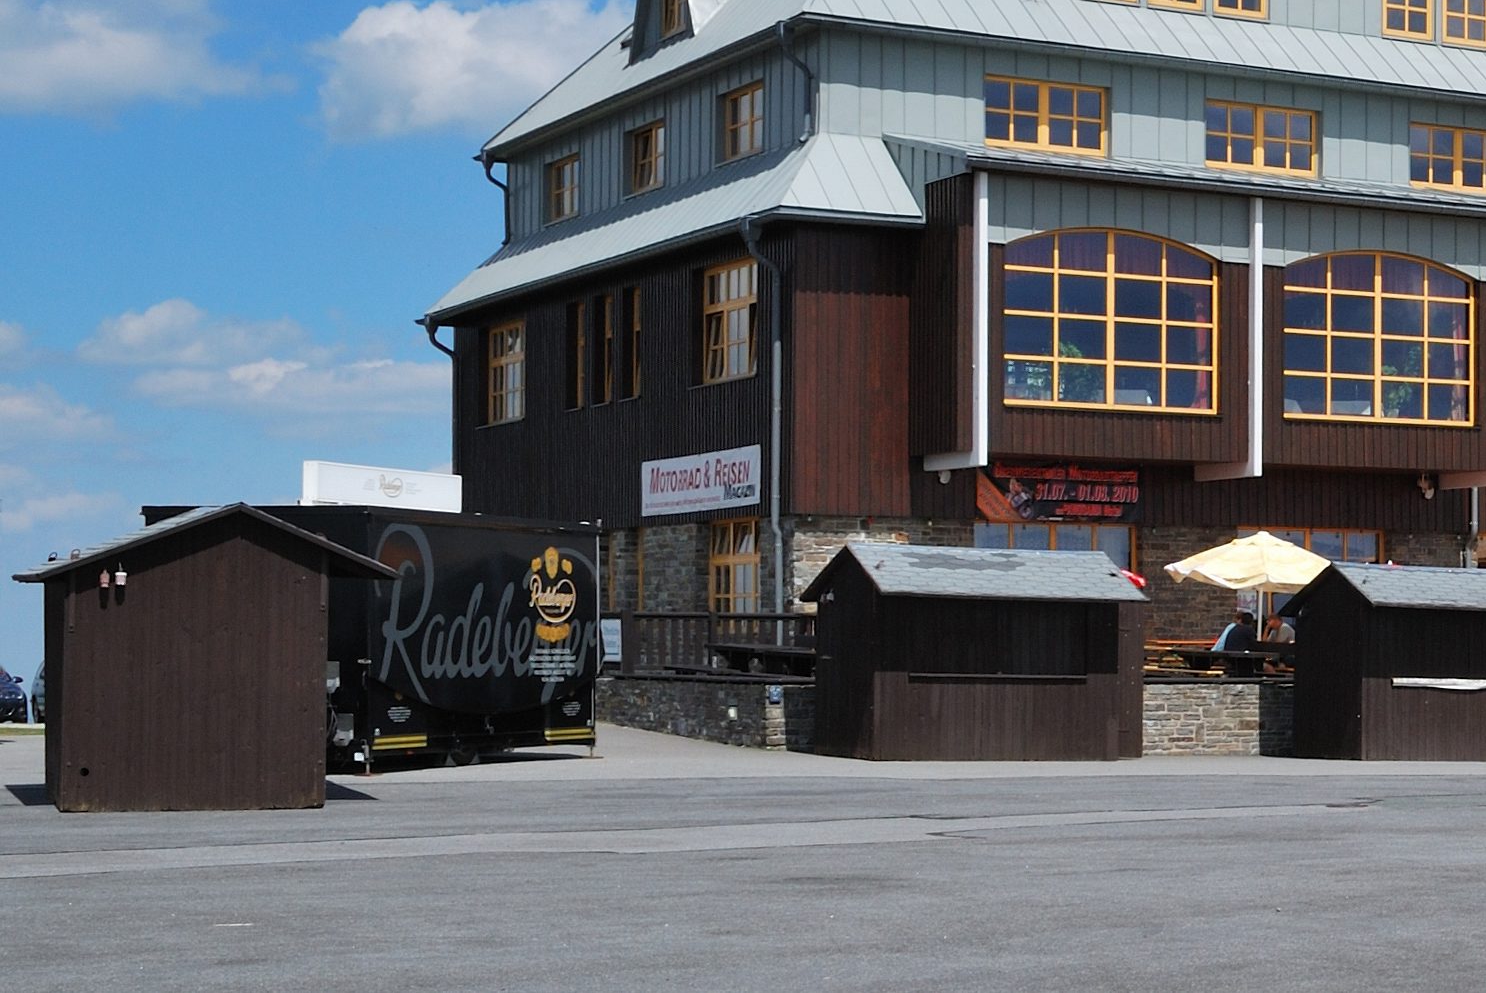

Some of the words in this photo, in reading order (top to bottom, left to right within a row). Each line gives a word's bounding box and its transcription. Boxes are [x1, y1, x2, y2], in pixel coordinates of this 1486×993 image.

[703, 459, 711, 489] &
[1035, 482, 1068, 501] 31.07.
[1112, 485, 1139, 503] 2010
